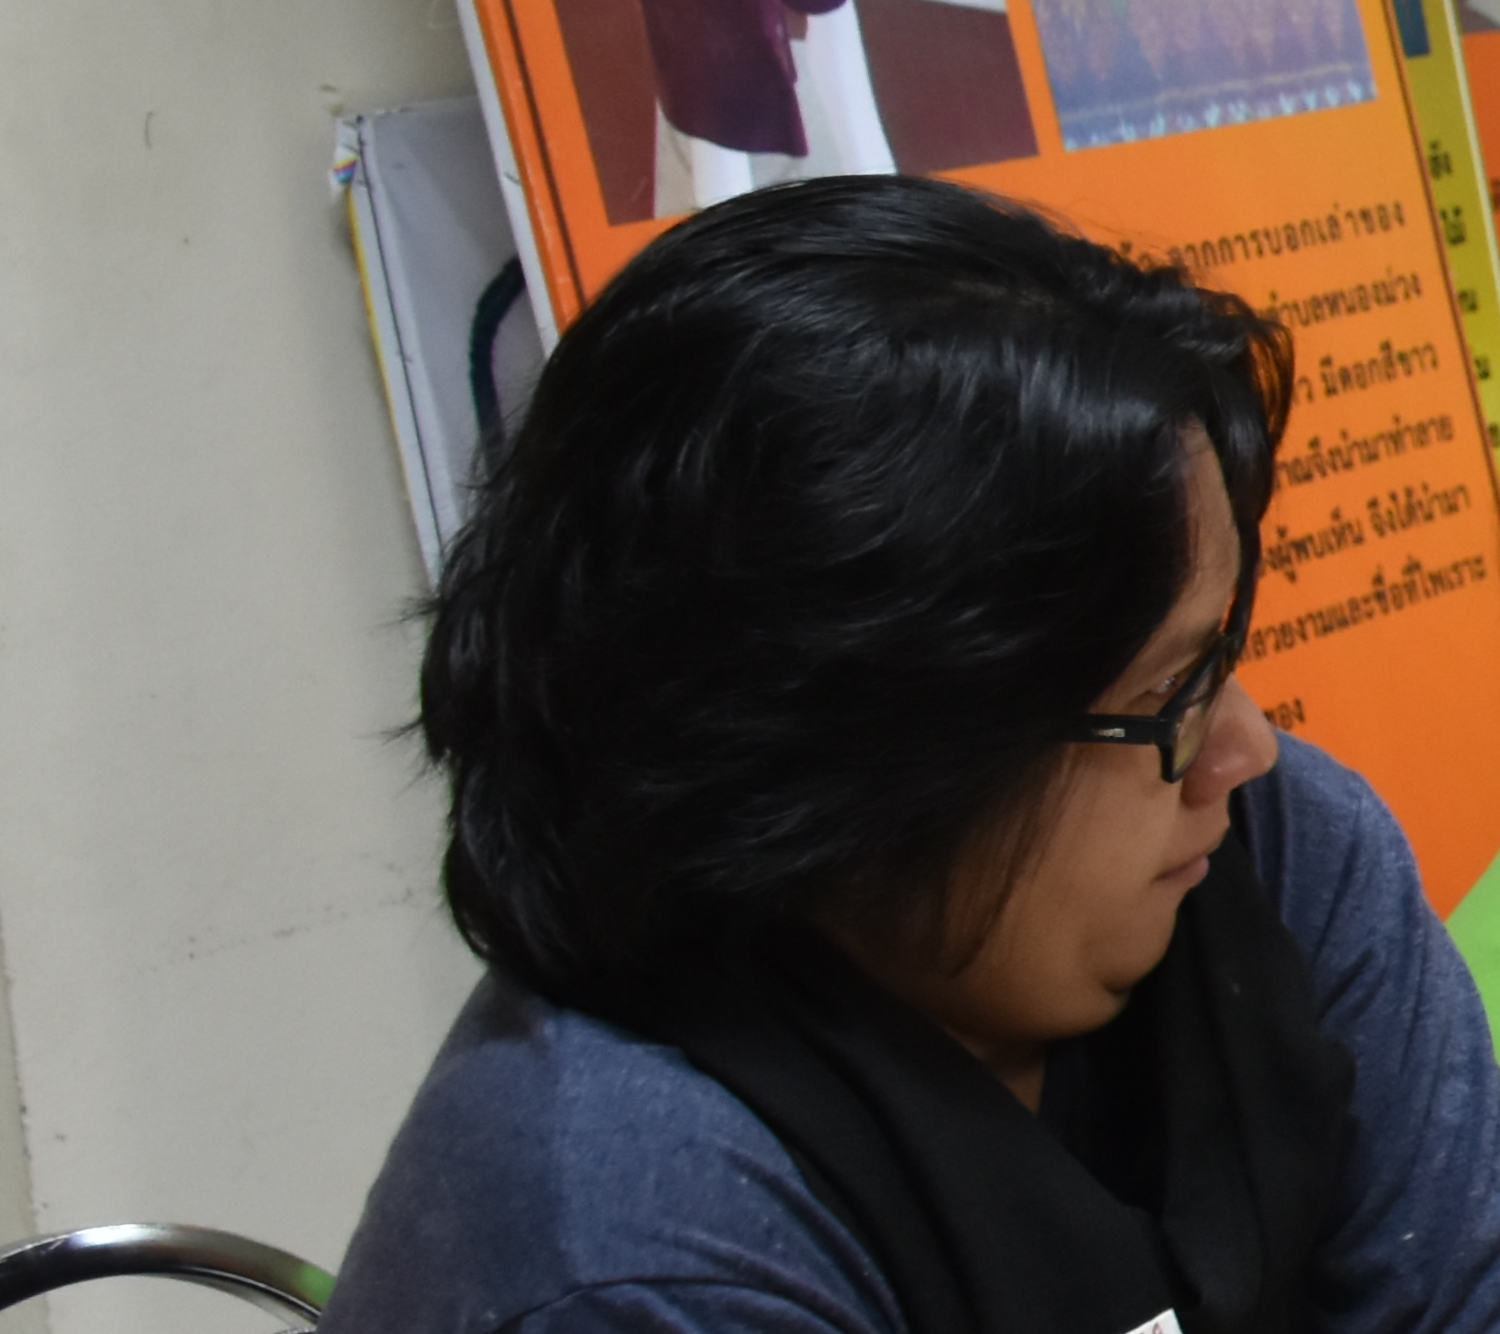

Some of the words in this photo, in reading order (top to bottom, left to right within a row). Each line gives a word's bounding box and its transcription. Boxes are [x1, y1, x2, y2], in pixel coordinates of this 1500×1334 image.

[1319, 339, 1440, 397] มีดอกสีขาว
[1367, 482, 1473, 539] จึงได้นำมา
[1239, 553, 1489, 666] สวยงามและชื่อที่ไพเราะ
